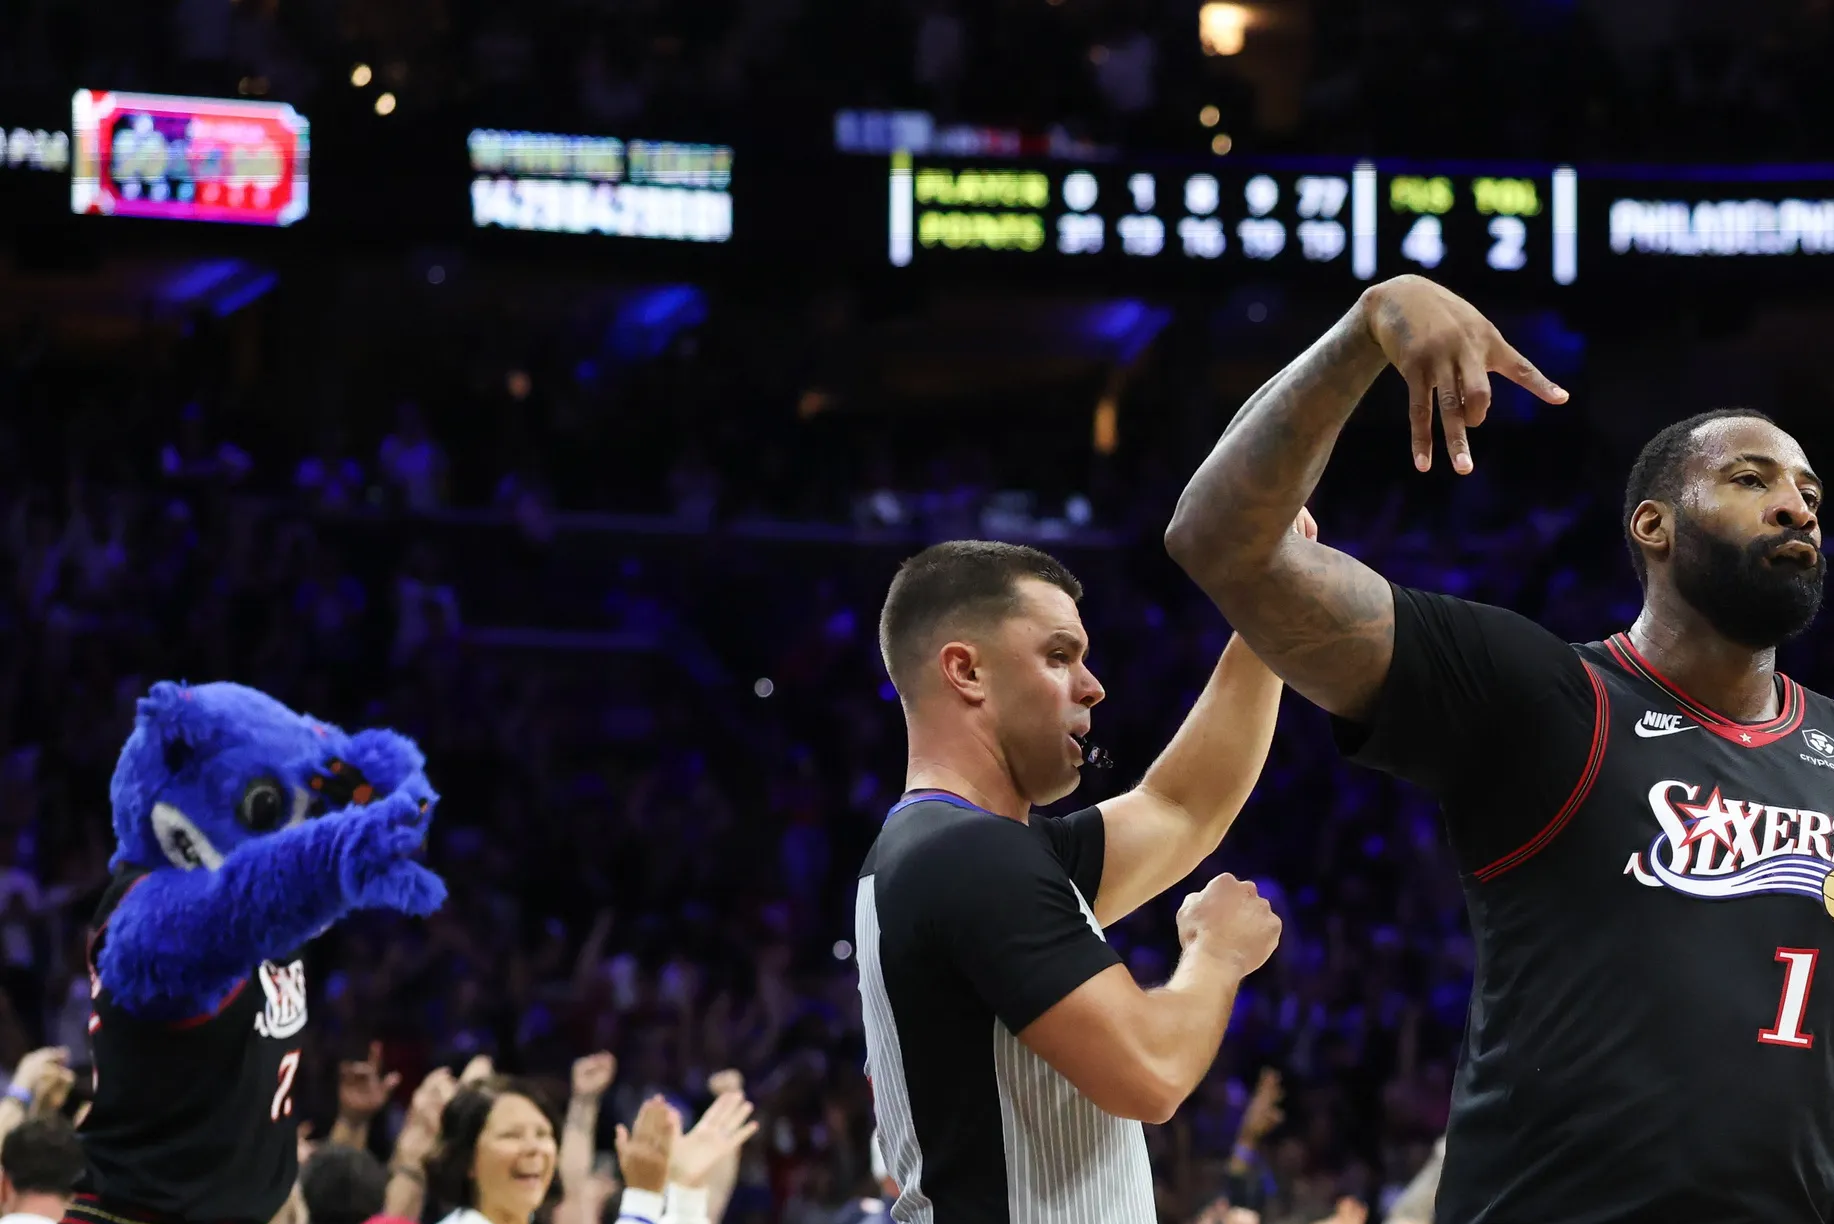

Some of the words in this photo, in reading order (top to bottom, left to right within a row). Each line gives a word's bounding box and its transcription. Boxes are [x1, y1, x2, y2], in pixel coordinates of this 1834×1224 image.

[1127, 172, 1156, 212] 1
[1401, 214, 1447, 268] 4
[1486, 215, 1527, 271] 2
[1642, 710, 1683, 731] NIKE
[1757, 946, 1820, 1049] 1
